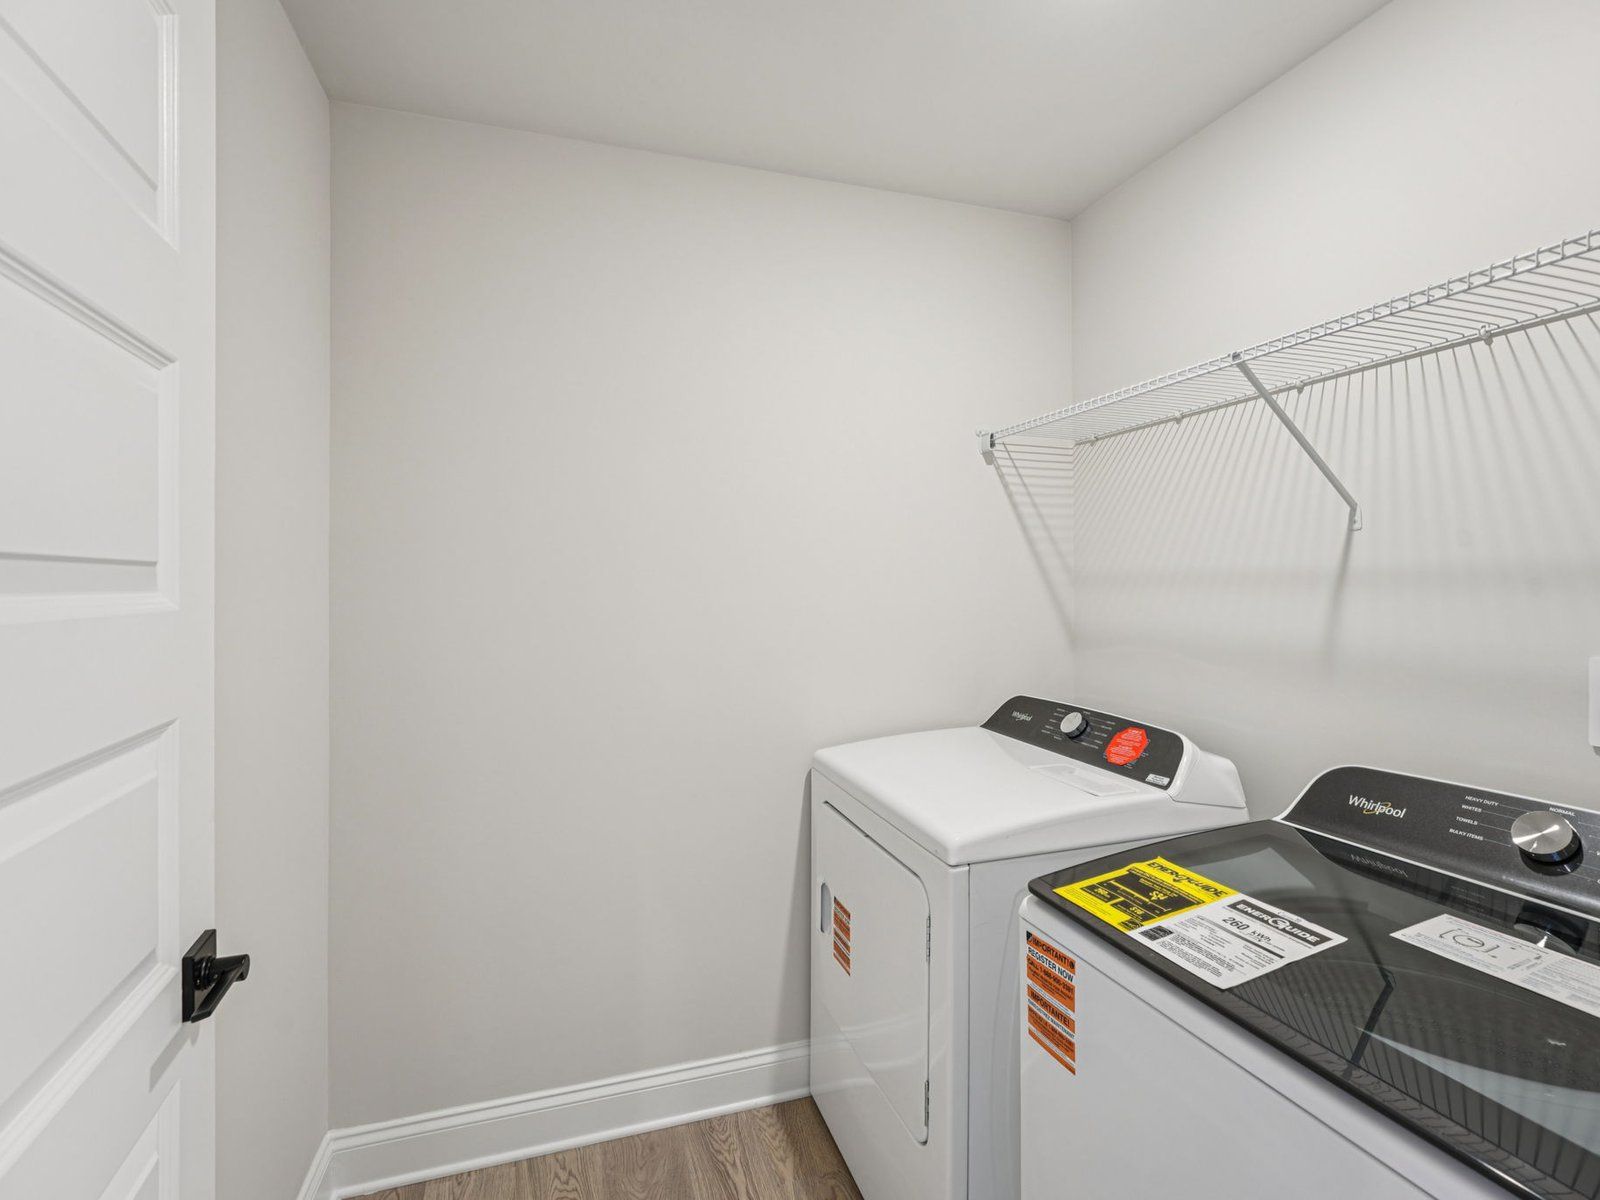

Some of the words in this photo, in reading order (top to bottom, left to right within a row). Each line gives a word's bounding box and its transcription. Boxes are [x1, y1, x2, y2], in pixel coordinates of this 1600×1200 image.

[1348, 794, 1407, 819] Whirlpool
[1464, 795, 1483, 804] HEAVY
[1483, 799, 1499, 807] DUTY
[1461, 804, 1482, 813] WHITES
[1549, 807, 1576, 817] NORMAL
[1456, 816, 1478, 826] TOWELS
[1449, 828, 1467, 837] BULKY
[1467, 832, 1484, 842] ITEMS
[1221, 916, 1250, 931] 260
[1250, 930, 1272, 943] kWh
[1028, 946, 1057, 972] REGISTER
[1057, 967, 1074, 983] NOW
